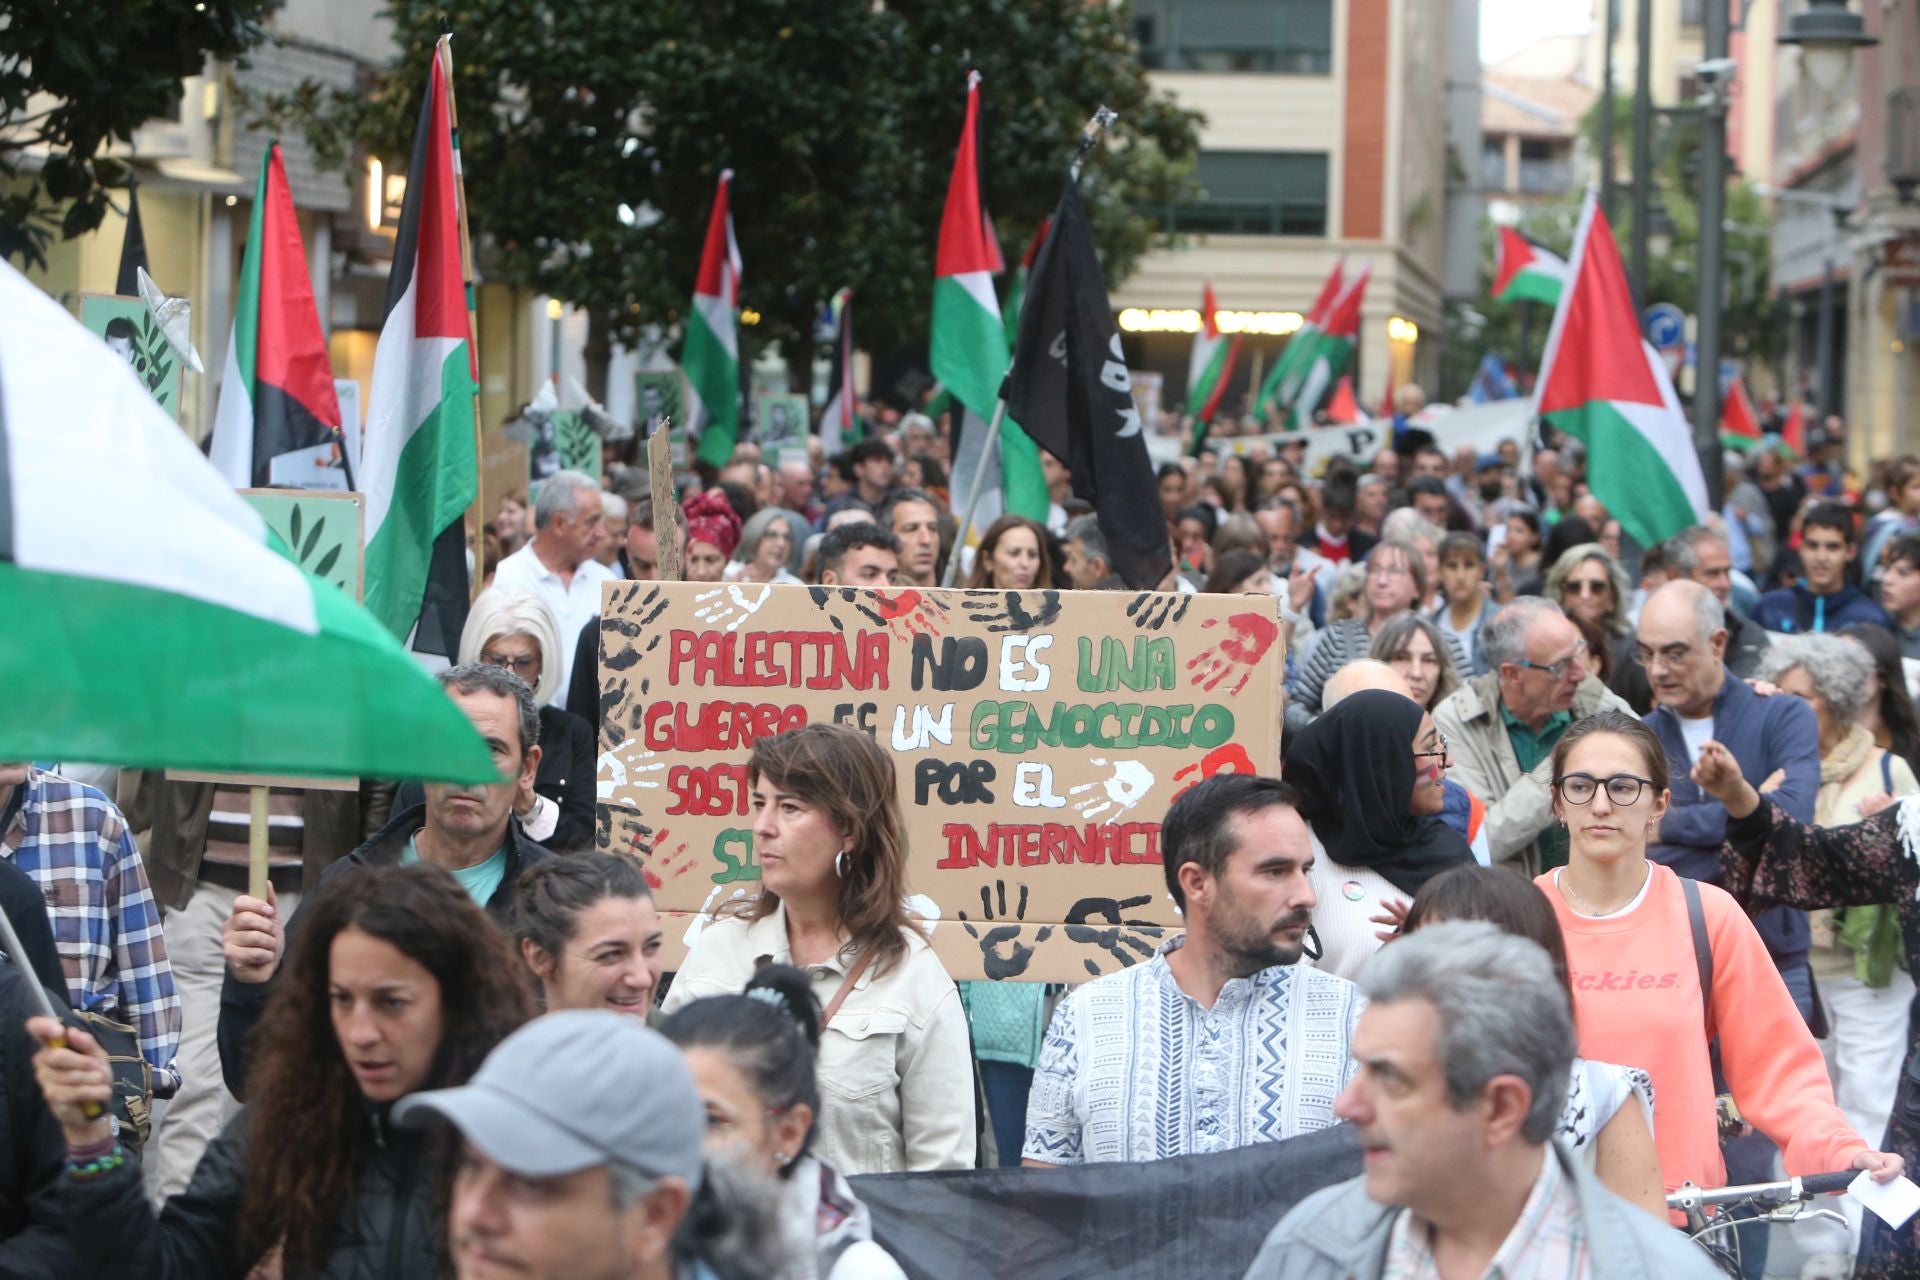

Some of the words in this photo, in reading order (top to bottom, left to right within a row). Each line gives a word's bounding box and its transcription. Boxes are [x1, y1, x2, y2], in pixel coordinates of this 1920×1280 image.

[668, 629, 889, 691] PALESTINA
[911, 633, 988, 691] NO
[1000, 635, 1053, 692] ES
[1077, 635, 1176, 692] UNA
[891, 702, 955, 751] UN
[969, 700, 1235, 753] GENOCIDIO
[665, 762, 750, 816] SOST
[914, 758, 996, 805] POR
[1013, 761, 1067, 808] EL
[937, 822, 1165, 869] INTERNACI
